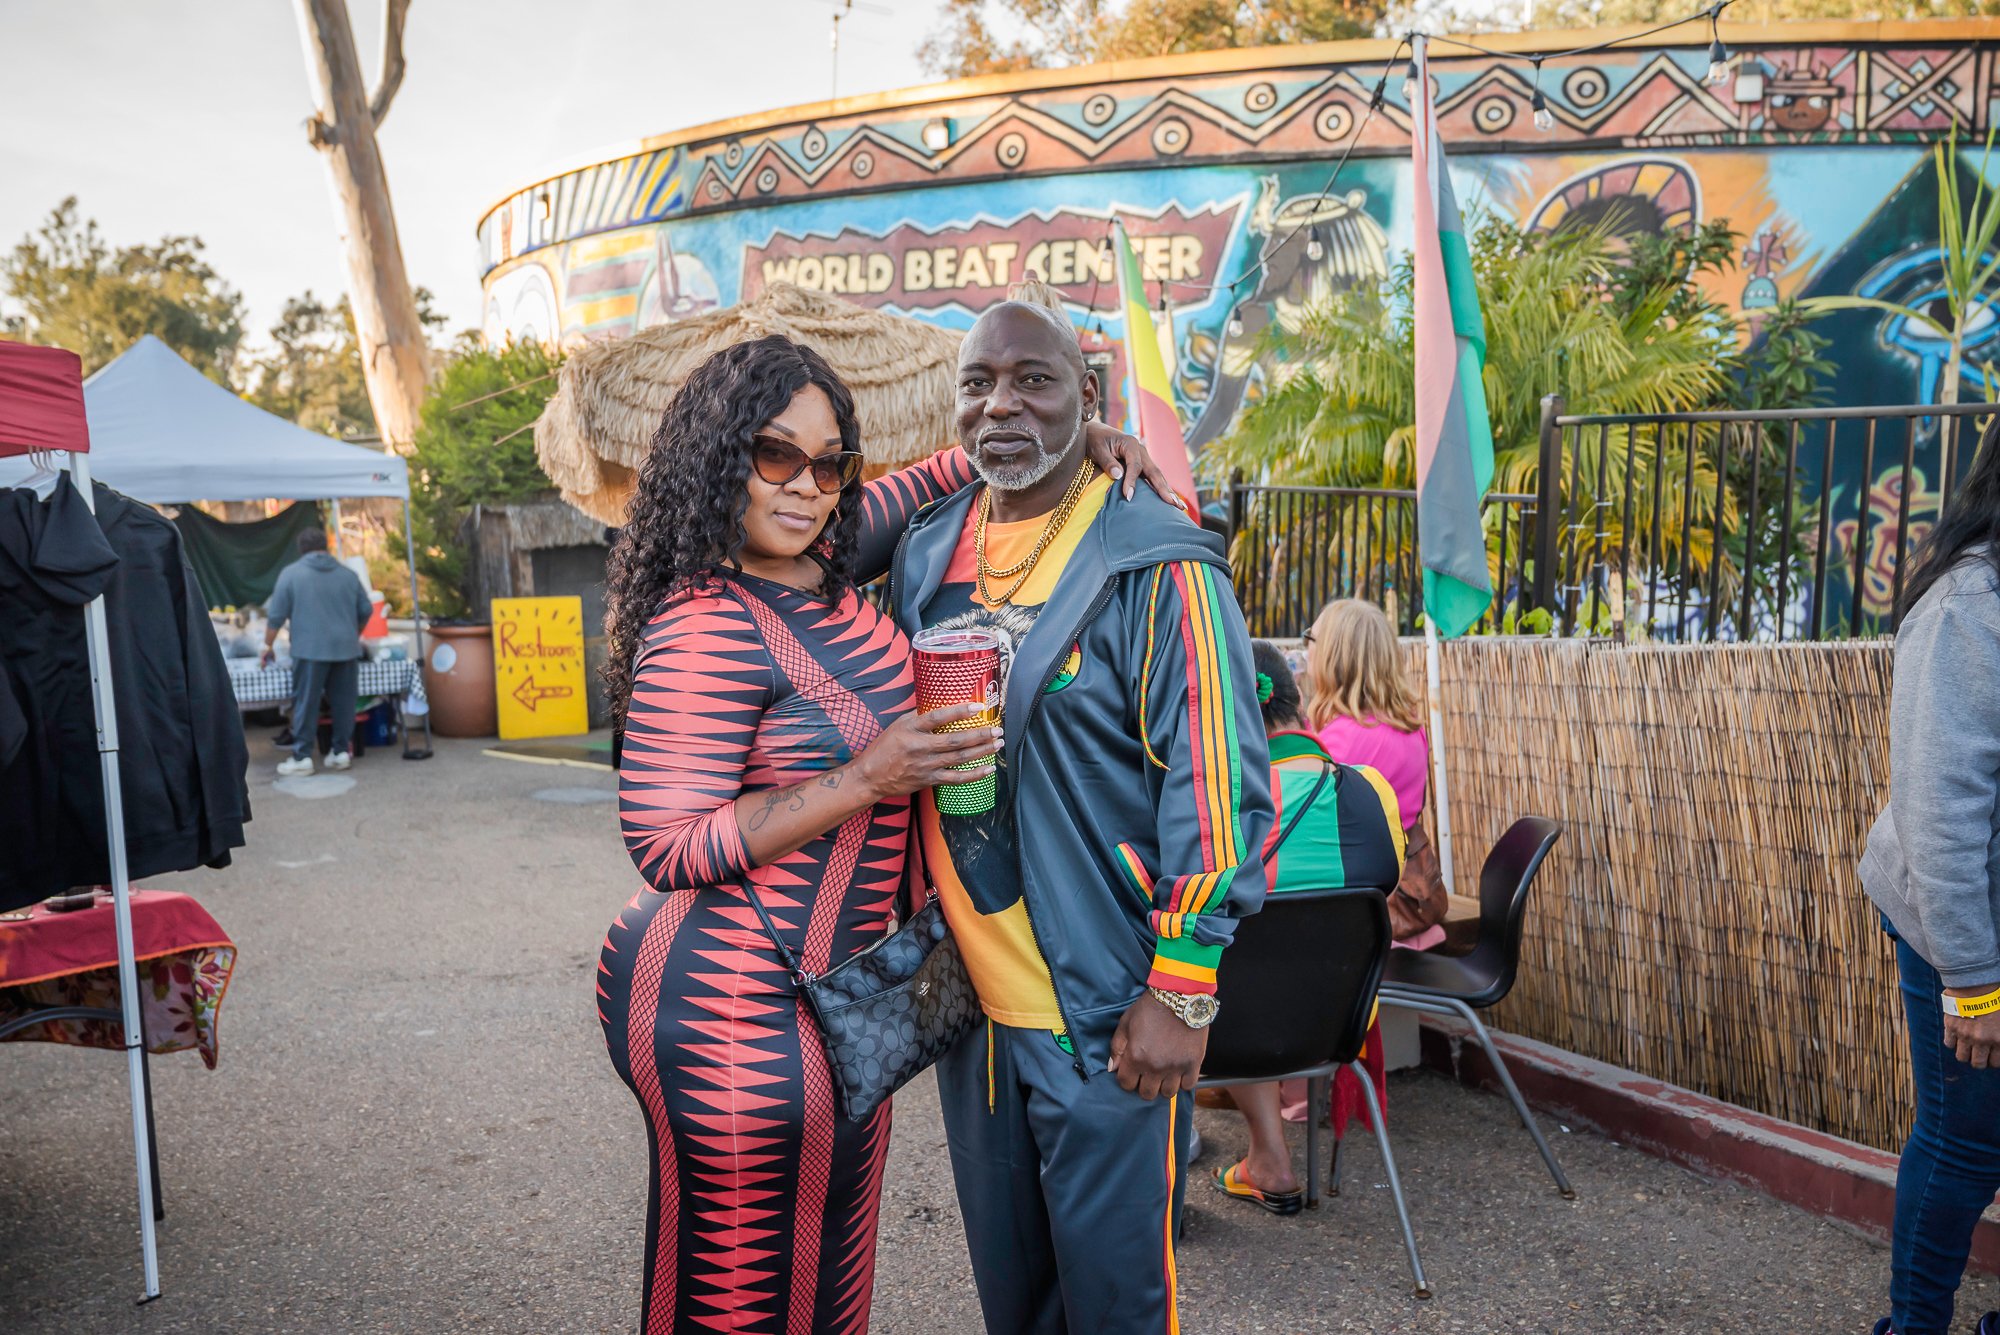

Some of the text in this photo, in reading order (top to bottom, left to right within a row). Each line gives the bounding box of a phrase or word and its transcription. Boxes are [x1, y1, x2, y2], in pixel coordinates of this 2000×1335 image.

[761, 252, 894, 294] WORLD
[903, 242, 1019, 292] BEAT
[1963, 1002, 1990, 1011] TRIBUTE
